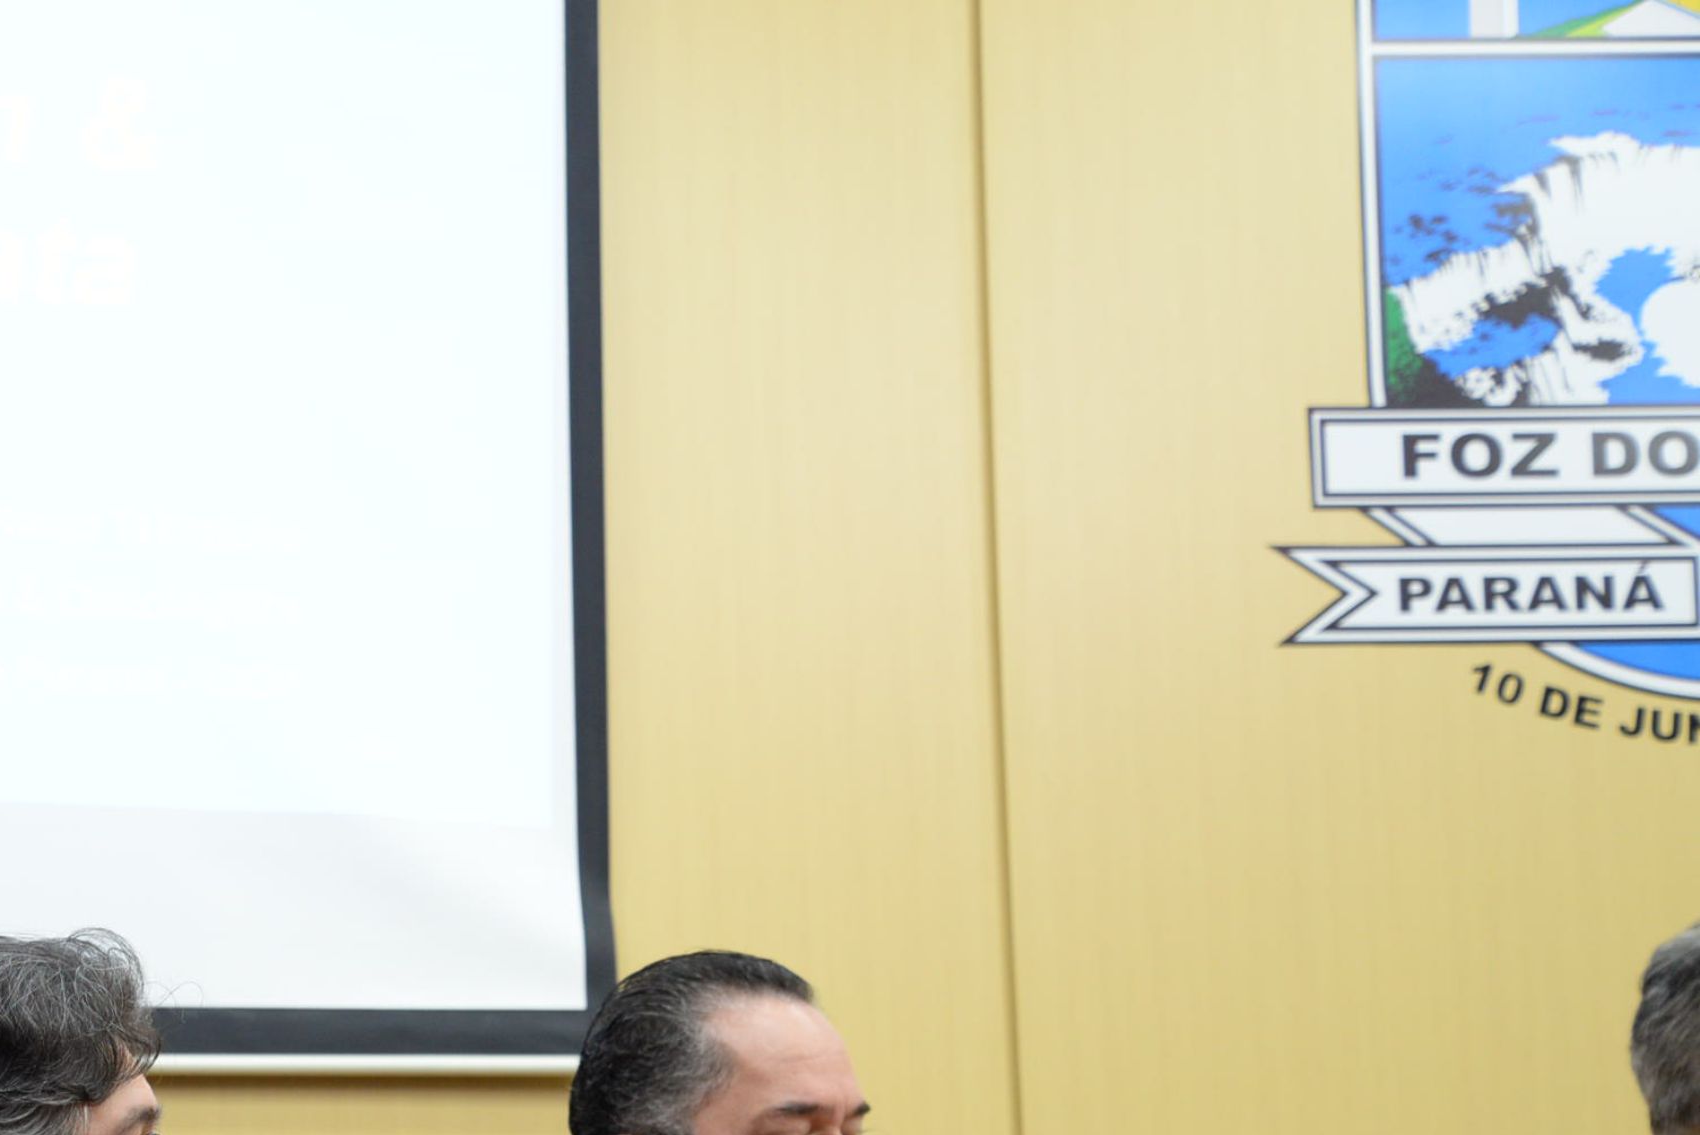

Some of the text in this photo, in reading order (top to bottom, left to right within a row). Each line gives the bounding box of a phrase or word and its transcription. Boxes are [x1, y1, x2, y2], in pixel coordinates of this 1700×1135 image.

[1401, 430, 1700, 478] FOZ DO
[1399, 560, 1665, 613] PARANÁ
[1472, 663, 1525, 704] 10
[1539, 686, 1603, 729] DE
